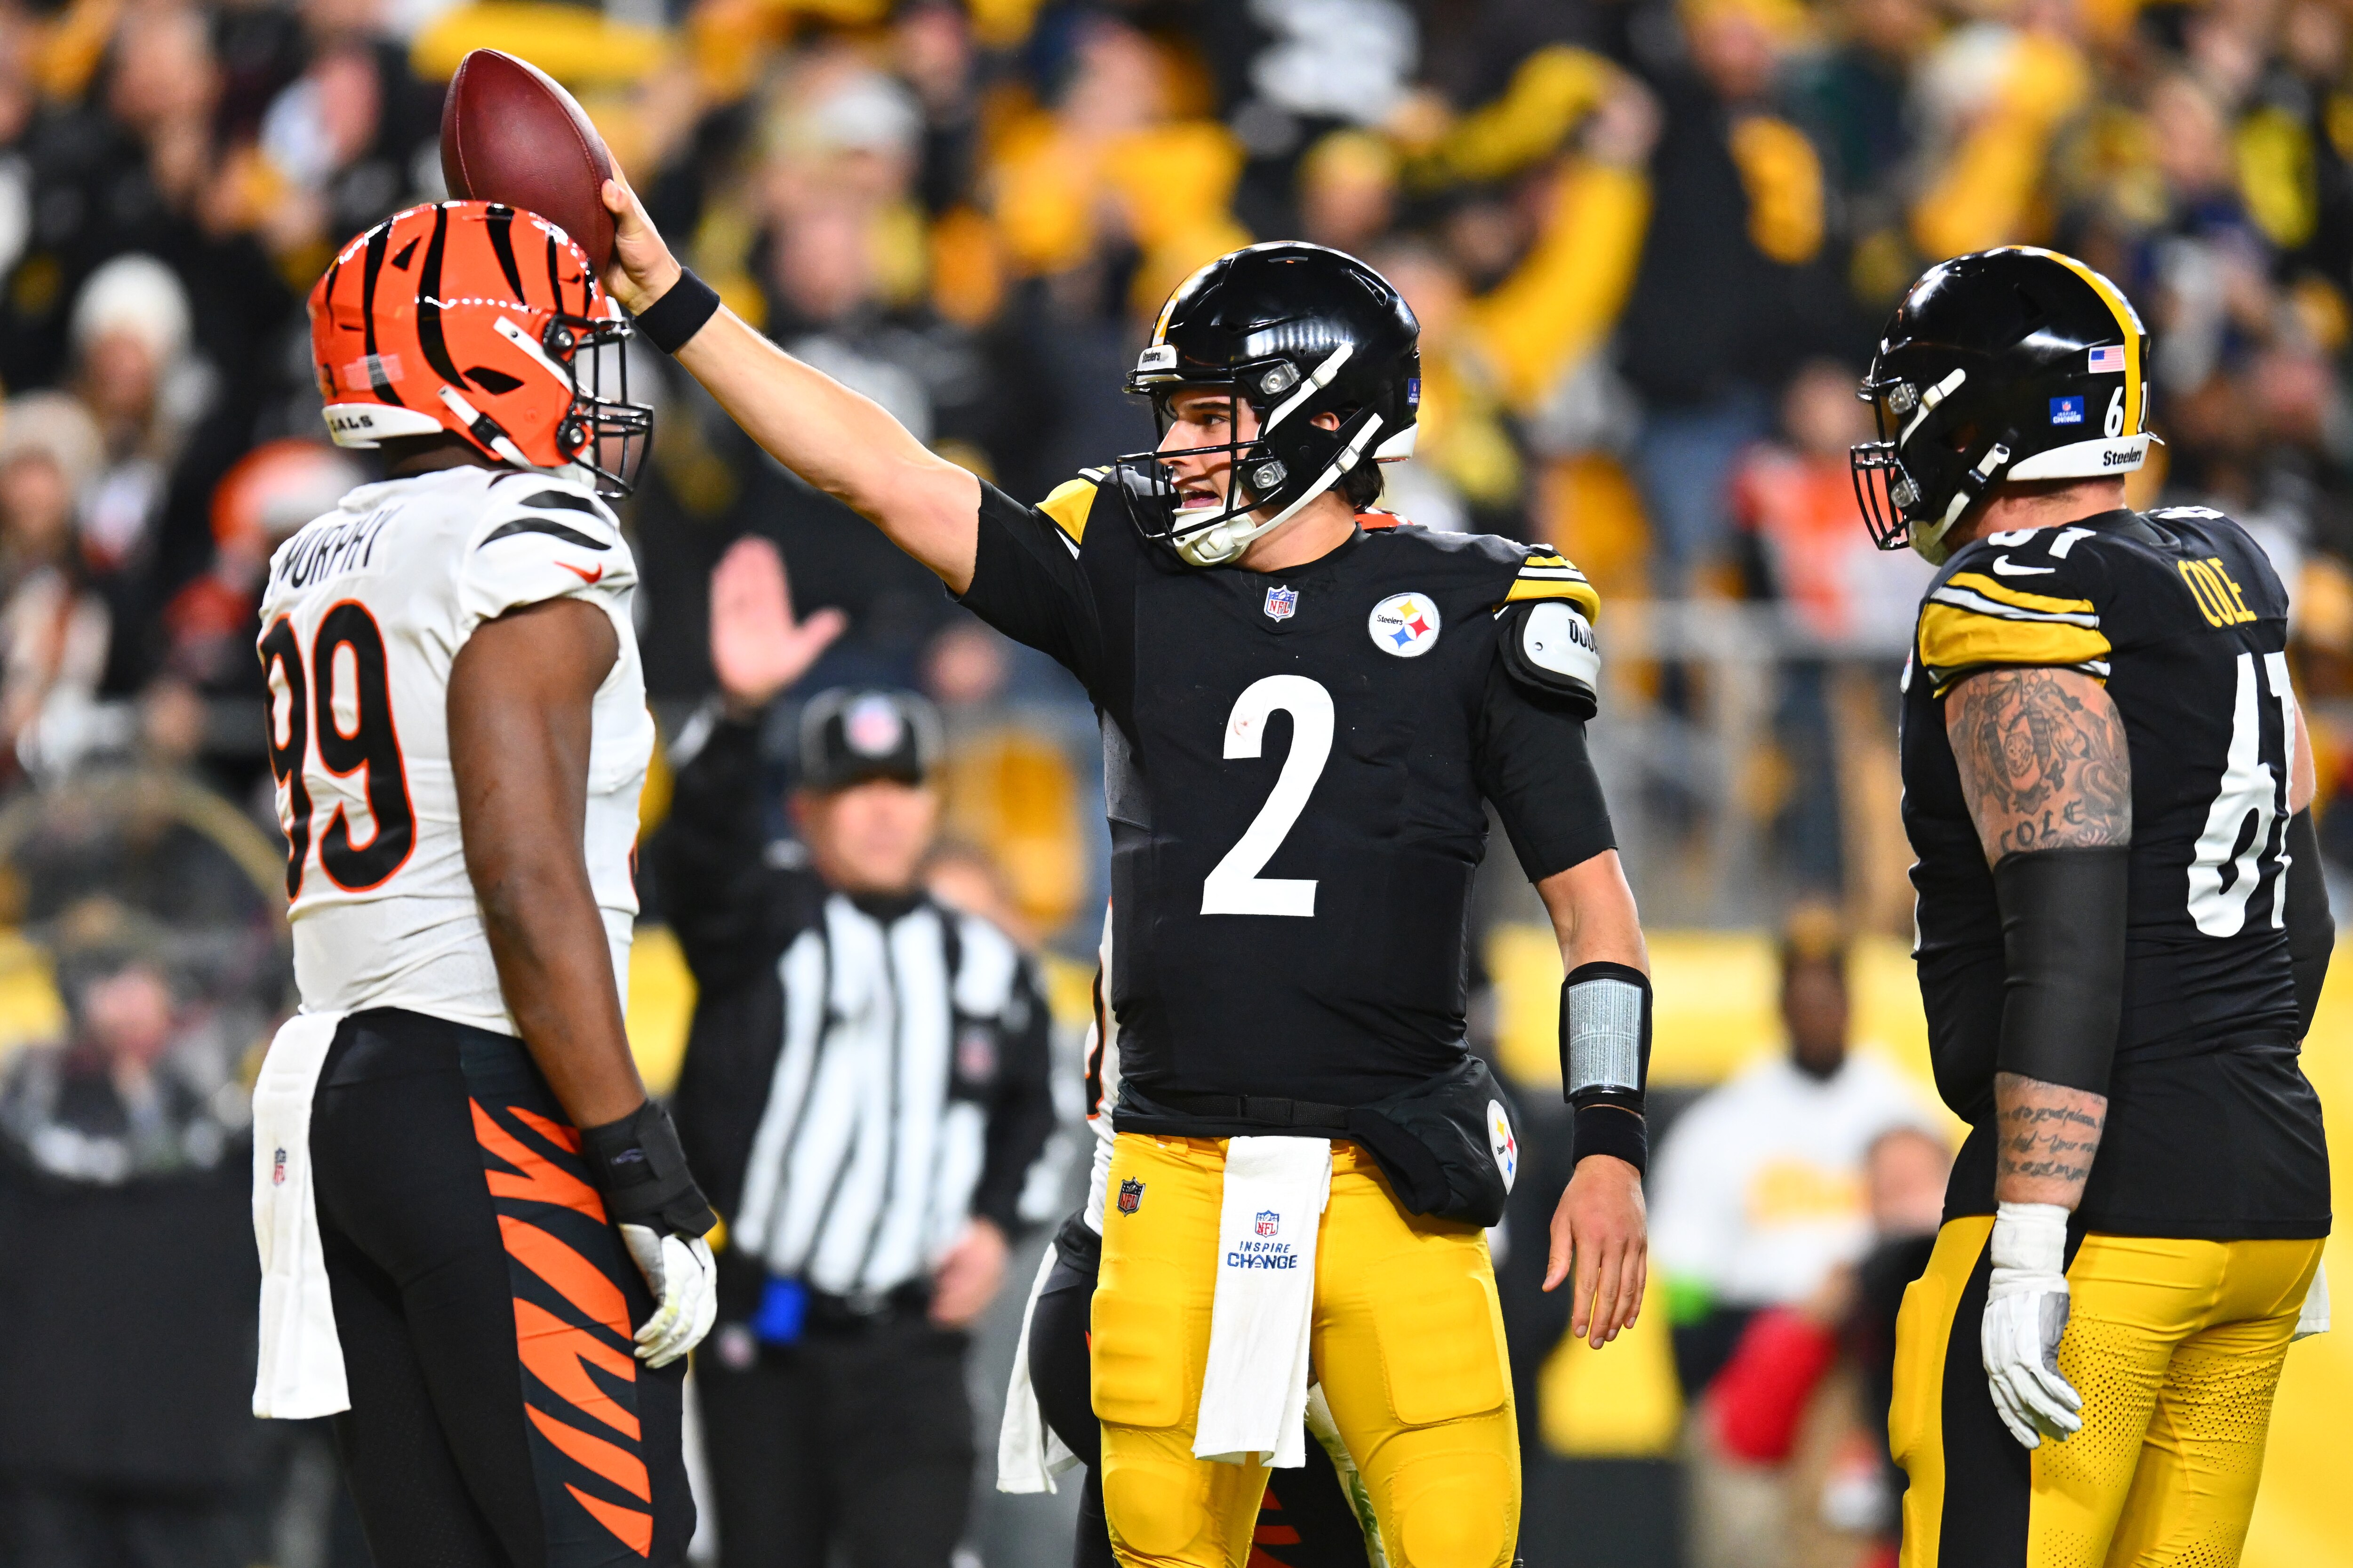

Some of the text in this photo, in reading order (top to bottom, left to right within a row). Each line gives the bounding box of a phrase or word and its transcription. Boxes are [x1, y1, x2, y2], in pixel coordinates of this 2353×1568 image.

[1142, 350, 1161, 364] Steelers
[2104, 381, 2147, 438] 61
[2103, 446, 2142, 467] Steelers
[2177, 557, 2257, 628] COLE
[1269, 600, 1289, 614] NFL
[1377, 614, 1403, 625] Steelers
[260, 598, 416, 903] 99
[1200, 674, 1335, 917] 2
[2187, 651, 2295, 937] 61
[2000, 799, 2088, 854] COLE
[1120, 1193, 1136, 1210] NFL
[1256, 1222, 1276, 1235] NFL
[1239, 1240, 1291, 1253] INSPIRE
[1227, 1252, 1298, 1269] CHANGE
